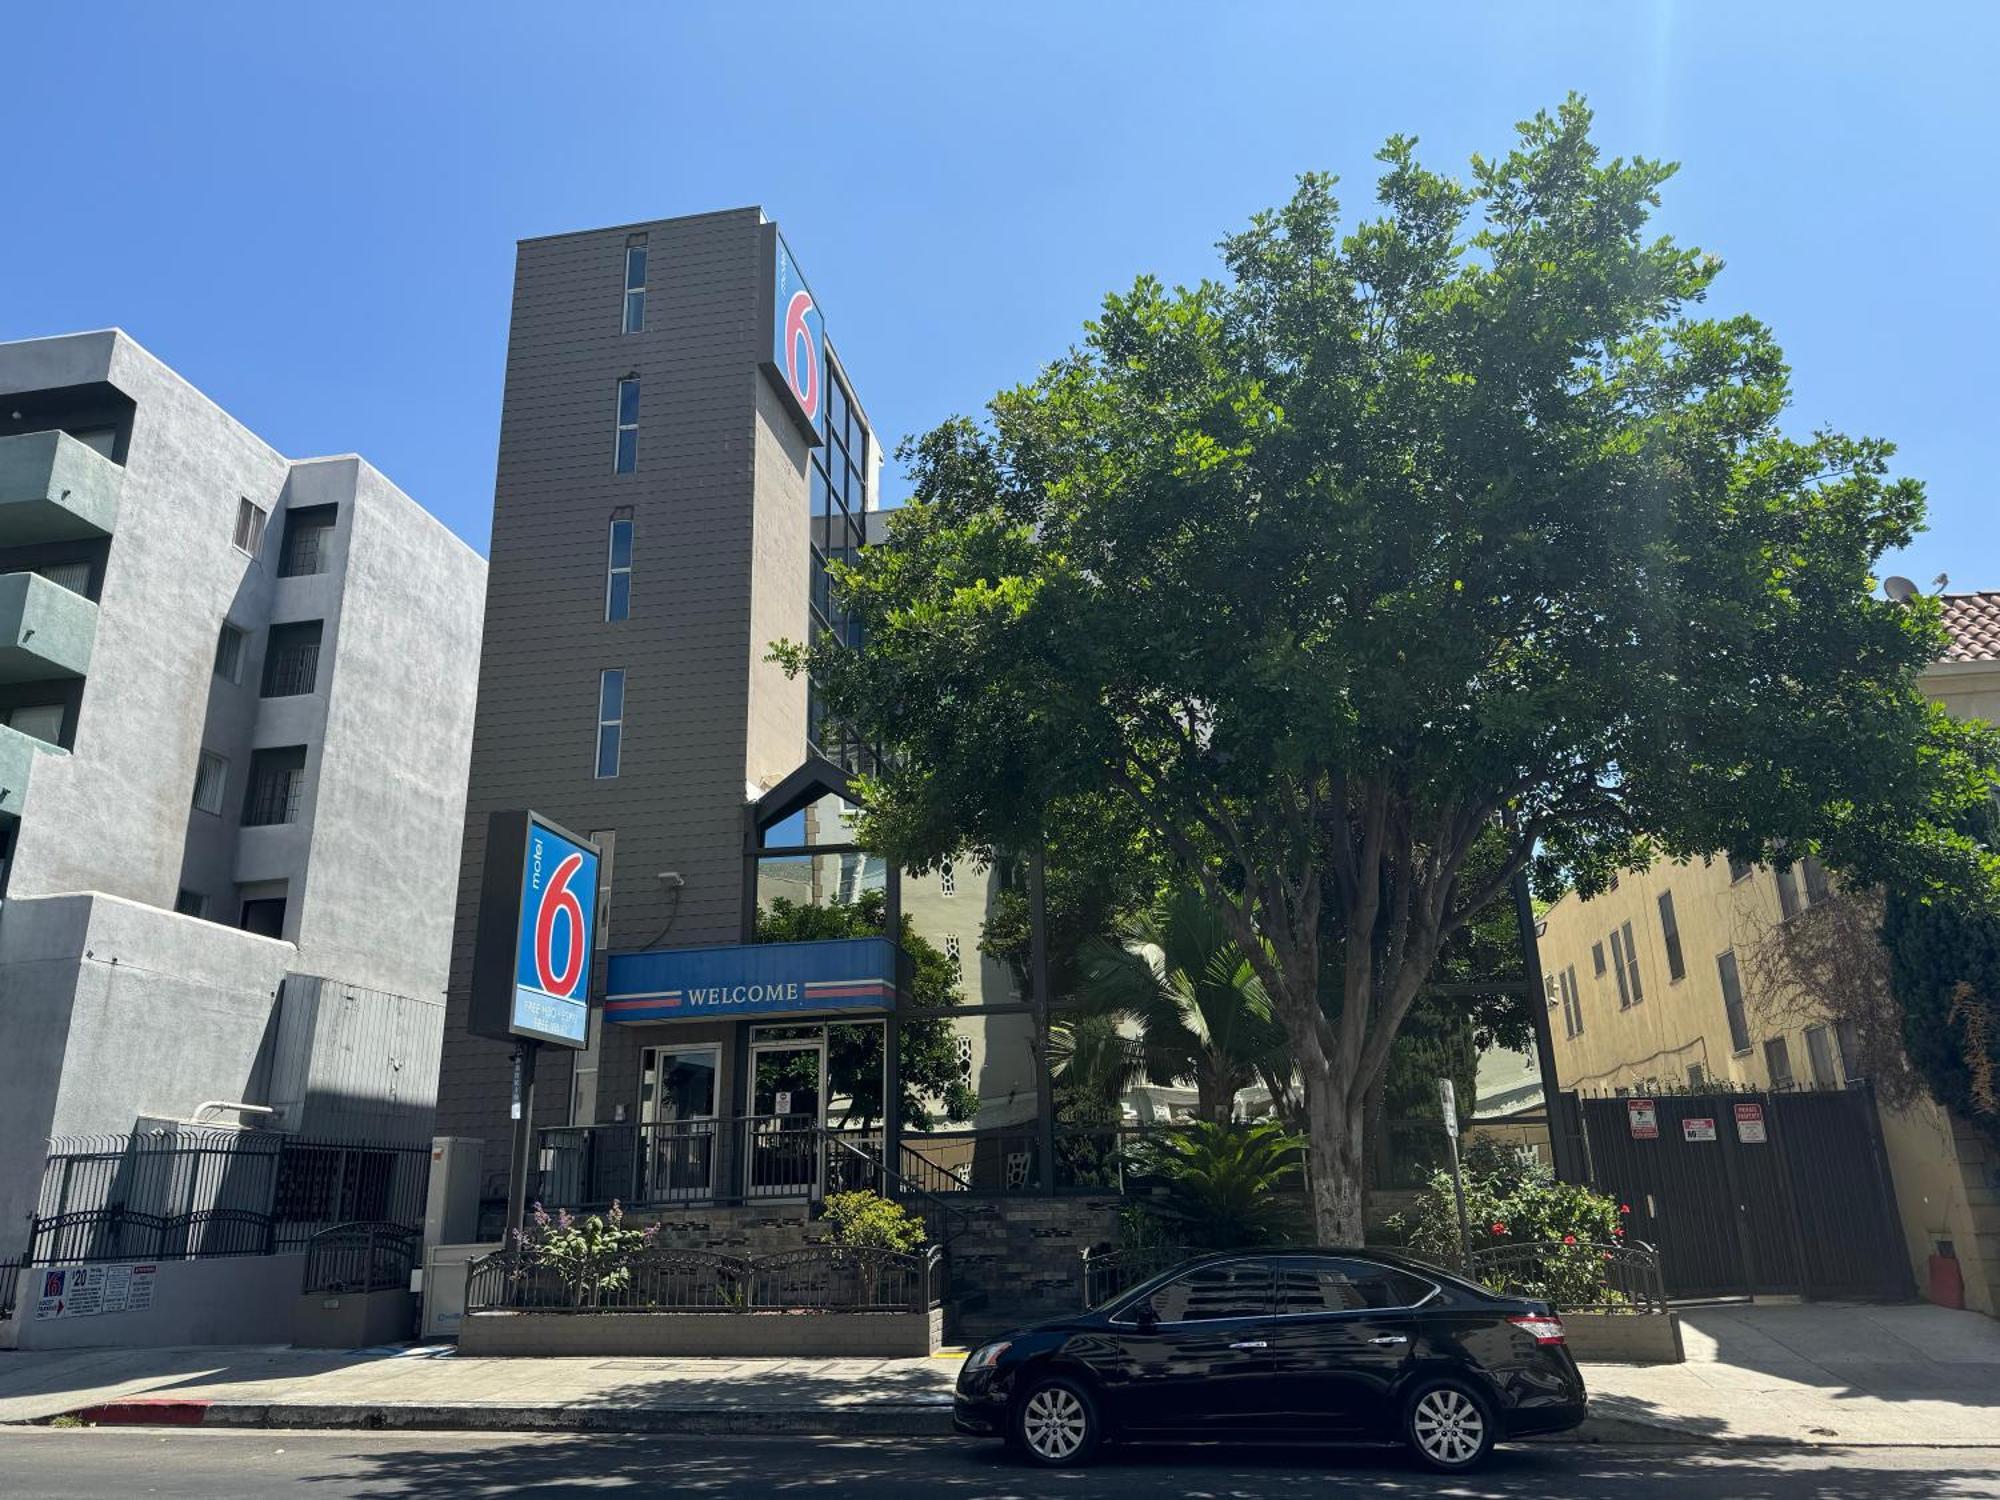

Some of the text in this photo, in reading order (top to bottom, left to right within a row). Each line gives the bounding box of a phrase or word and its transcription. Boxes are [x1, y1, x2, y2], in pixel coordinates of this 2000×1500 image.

[784, 289, 819, 421] 6
[532, 838, 544, 890] motel
[534, 852, 586, 998] 6
[687, 983, 799, 1006] WELCOME
